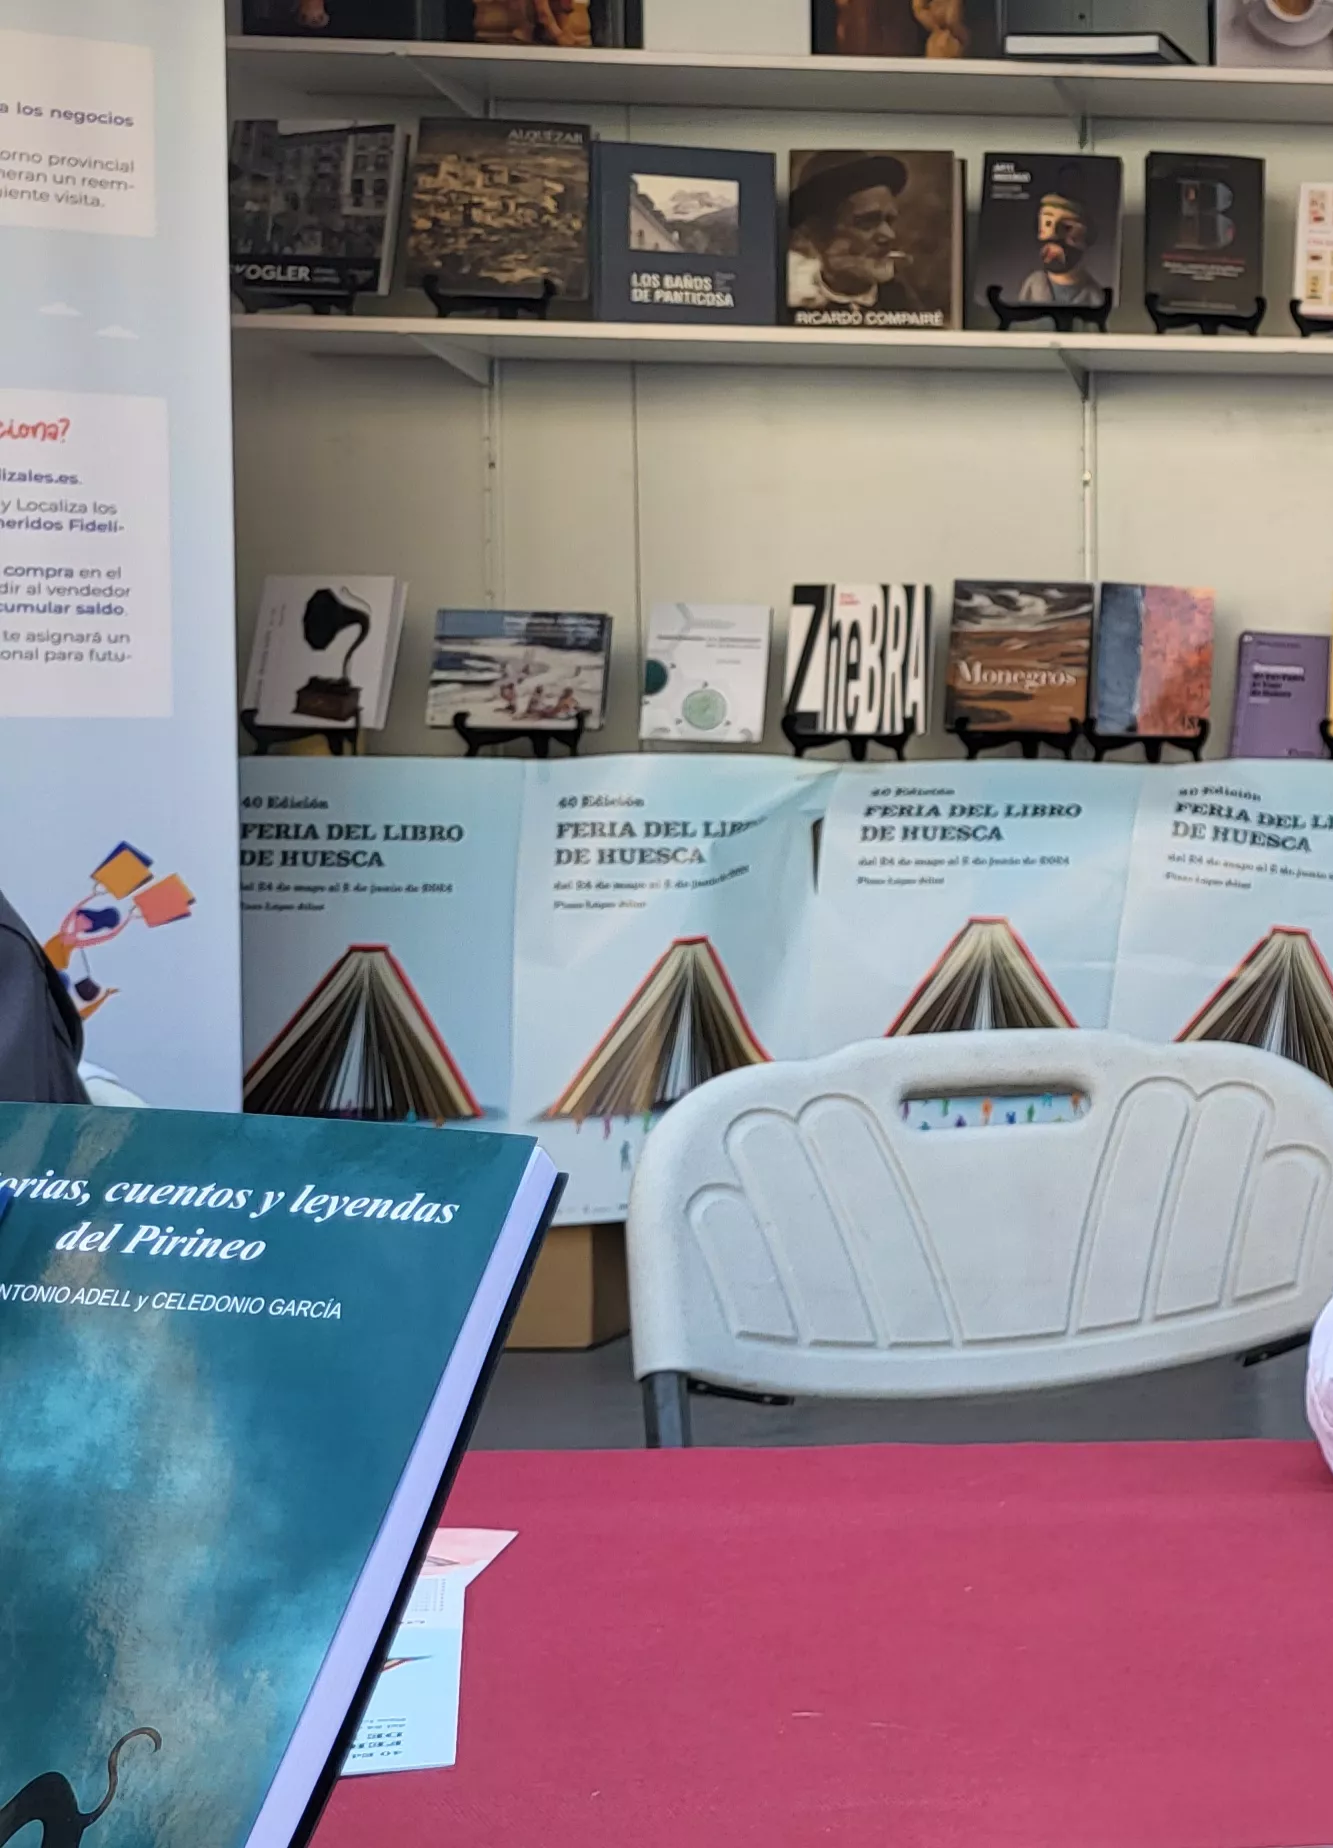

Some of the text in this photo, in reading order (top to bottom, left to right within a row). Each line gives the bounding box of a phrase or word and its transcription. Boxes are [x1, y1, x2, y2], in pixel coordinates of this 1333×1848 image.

[17, 101, 43, 117] los
[51, 108, 134, 127] negocios
[0, 150, 134, 173] orno provincial
[53, 174, 77, 186] un
[54, 190, 105, 208] visita.
[631, 271, 660, 288] LOS
[631, 288, 734, 308] DE PANTICOSA
[795, 310, 862, 325] RICARDO
[17, 498, 88, 514] Localiza
[93, 501, 118, 516] los
[3, 565, 122, 581] compra en el
[0, 582, 131, 598] dir al vendedor
[0, 602, 71, 616] cumular
[3, 630, 21, 643] te
[107, 631, 130, 644] un
[0, 647, 40, 661] onal
[44, 649, 84, 664] para
[958, 661, 1077, 690] Monegros
[864, 803, 1082, 819] FERIA DEL LIBRO
[1174, 801, 1250, 823] FERIA
[1256, 812, 1306, 830] DEL
[240, 823, 465, 843] FERIA DEL LIBRO
[556, 821, 697, 839] FERIA DEL
[860, 825, 1004, 842] DE HUESCA
[1172, 821, 1312, 853] DE HUESCA
[240, 850, 384, 868] DE HUESCA
[555, 847, 706, 866] DE HUESCA
[0, 1169, 460, 1227] orias, cuentos y leyendas
[55, 1221, 267, 1262] del Pirineo
[0, 1283, 342, 1320] NTONIO ADELL y CELEDONIO GARCÍA
